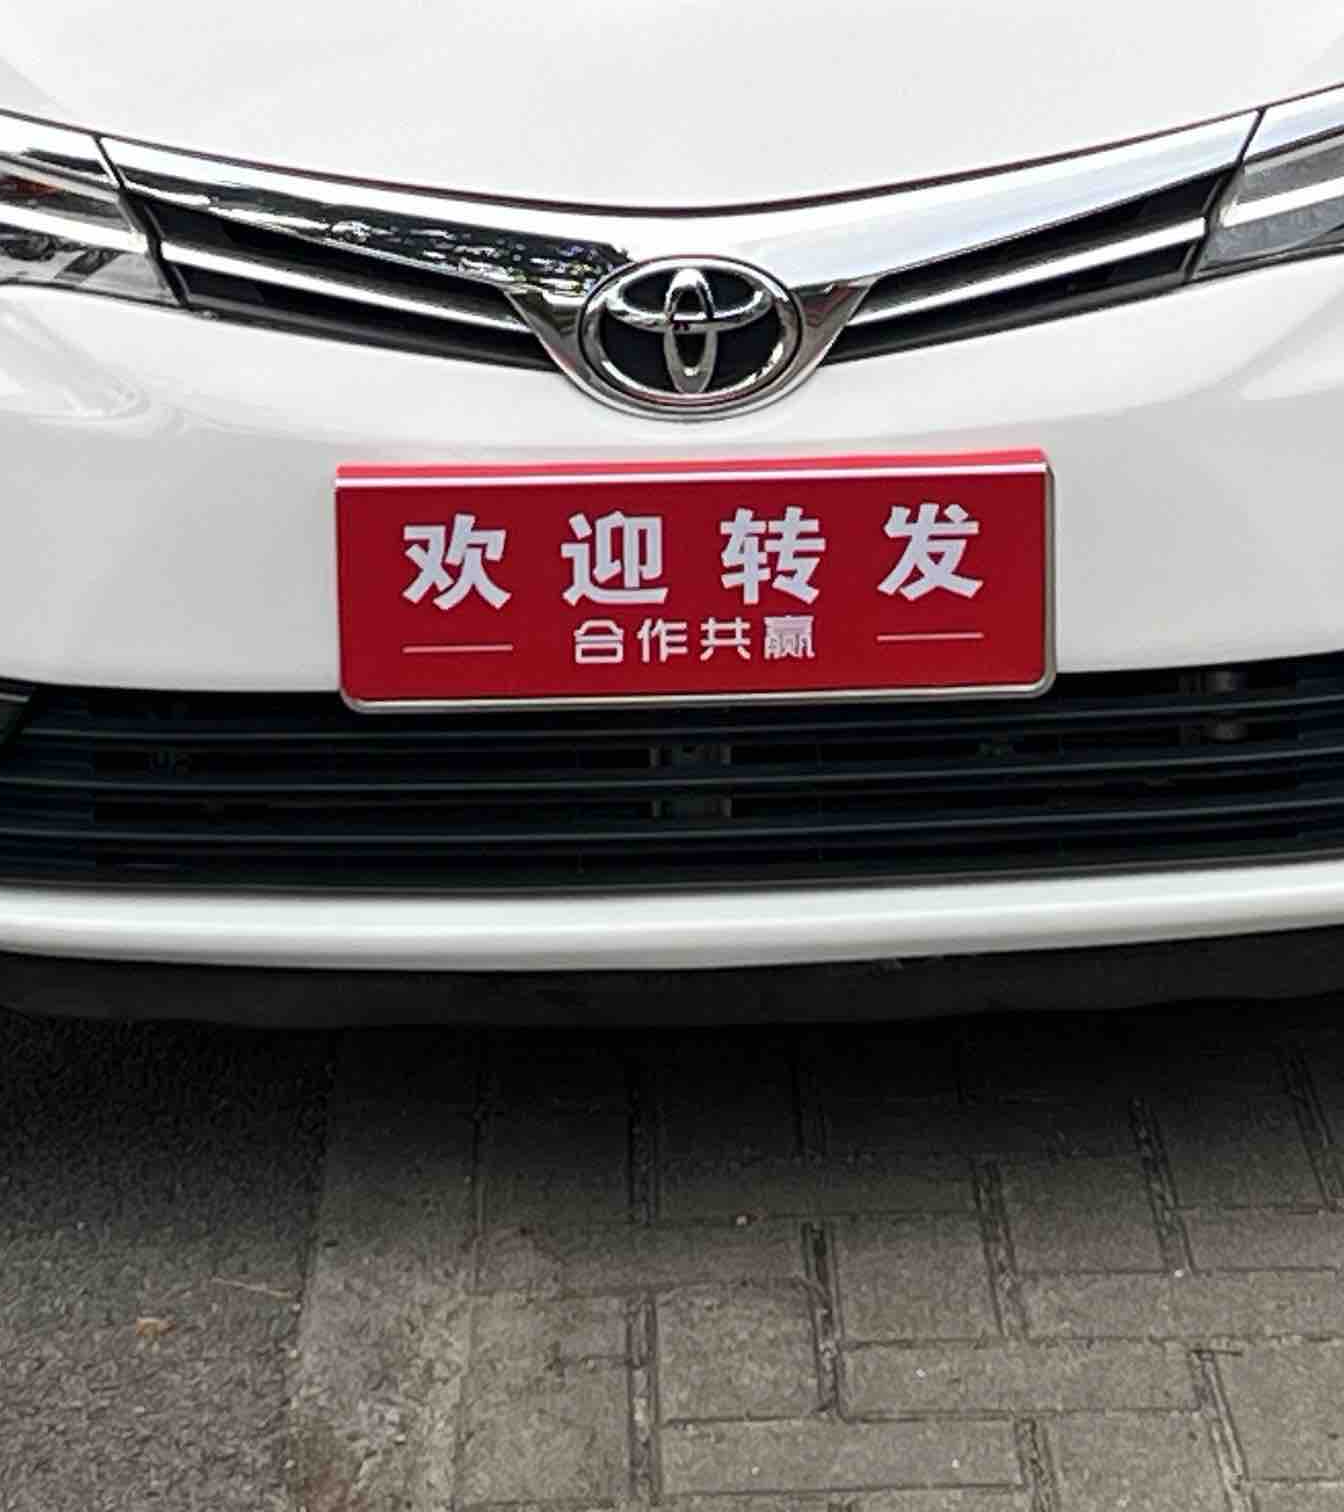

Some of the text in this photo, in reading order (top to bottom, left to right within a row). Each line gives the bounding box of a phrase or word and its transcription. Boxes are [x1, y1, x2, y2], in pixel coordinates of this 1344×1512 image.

[402, 502, 985, 610] 欢迎转发
[572, 614, 816, 665] 合作共赢
